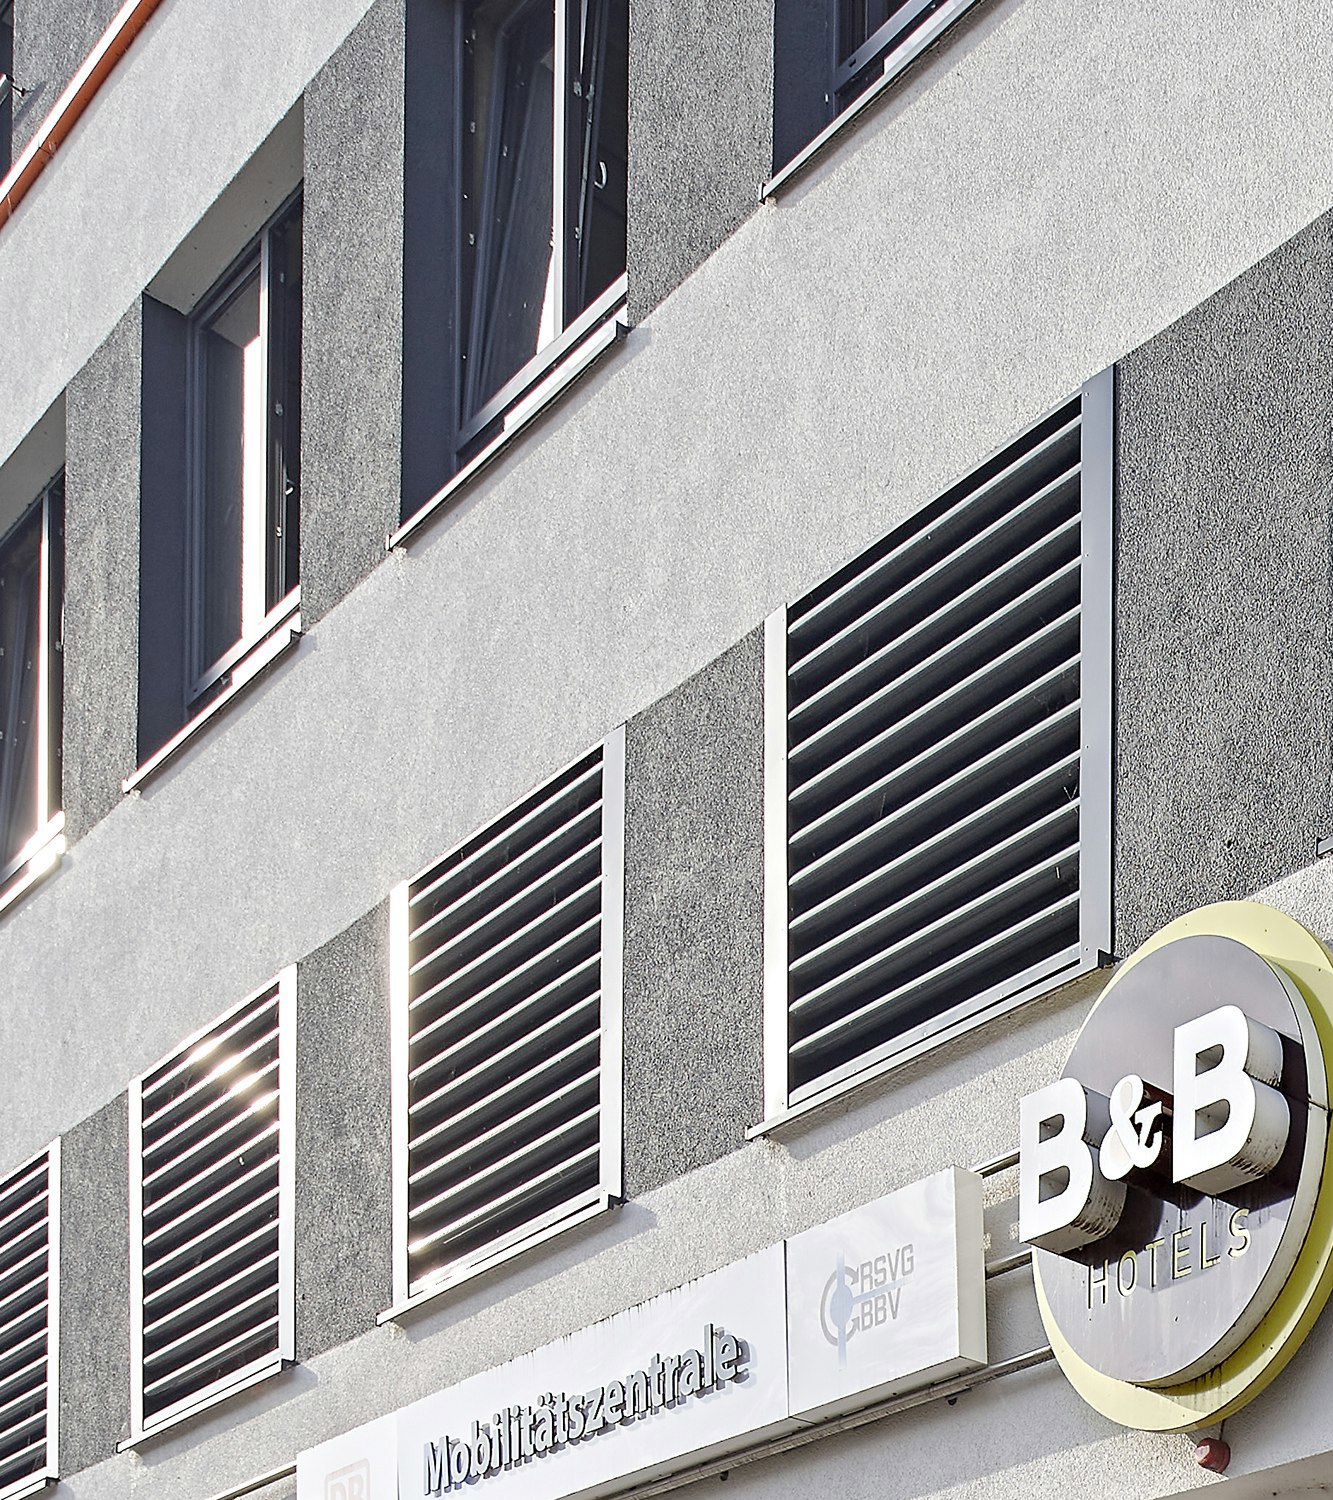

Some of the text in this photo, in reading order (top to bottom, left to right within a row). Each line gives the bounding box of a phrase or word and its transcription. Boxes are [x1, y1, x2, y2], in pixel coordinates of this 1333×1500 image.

[1019, 1003, 1275, 1245] B&B
[860, 1243, 915, 1293] RSVG
[1088, 1207, 1251, 1309] HOTELS
[861, 1287, 901, 1332] BBV
[423, 1322, 750, 1497] Mobilitätszentrale
